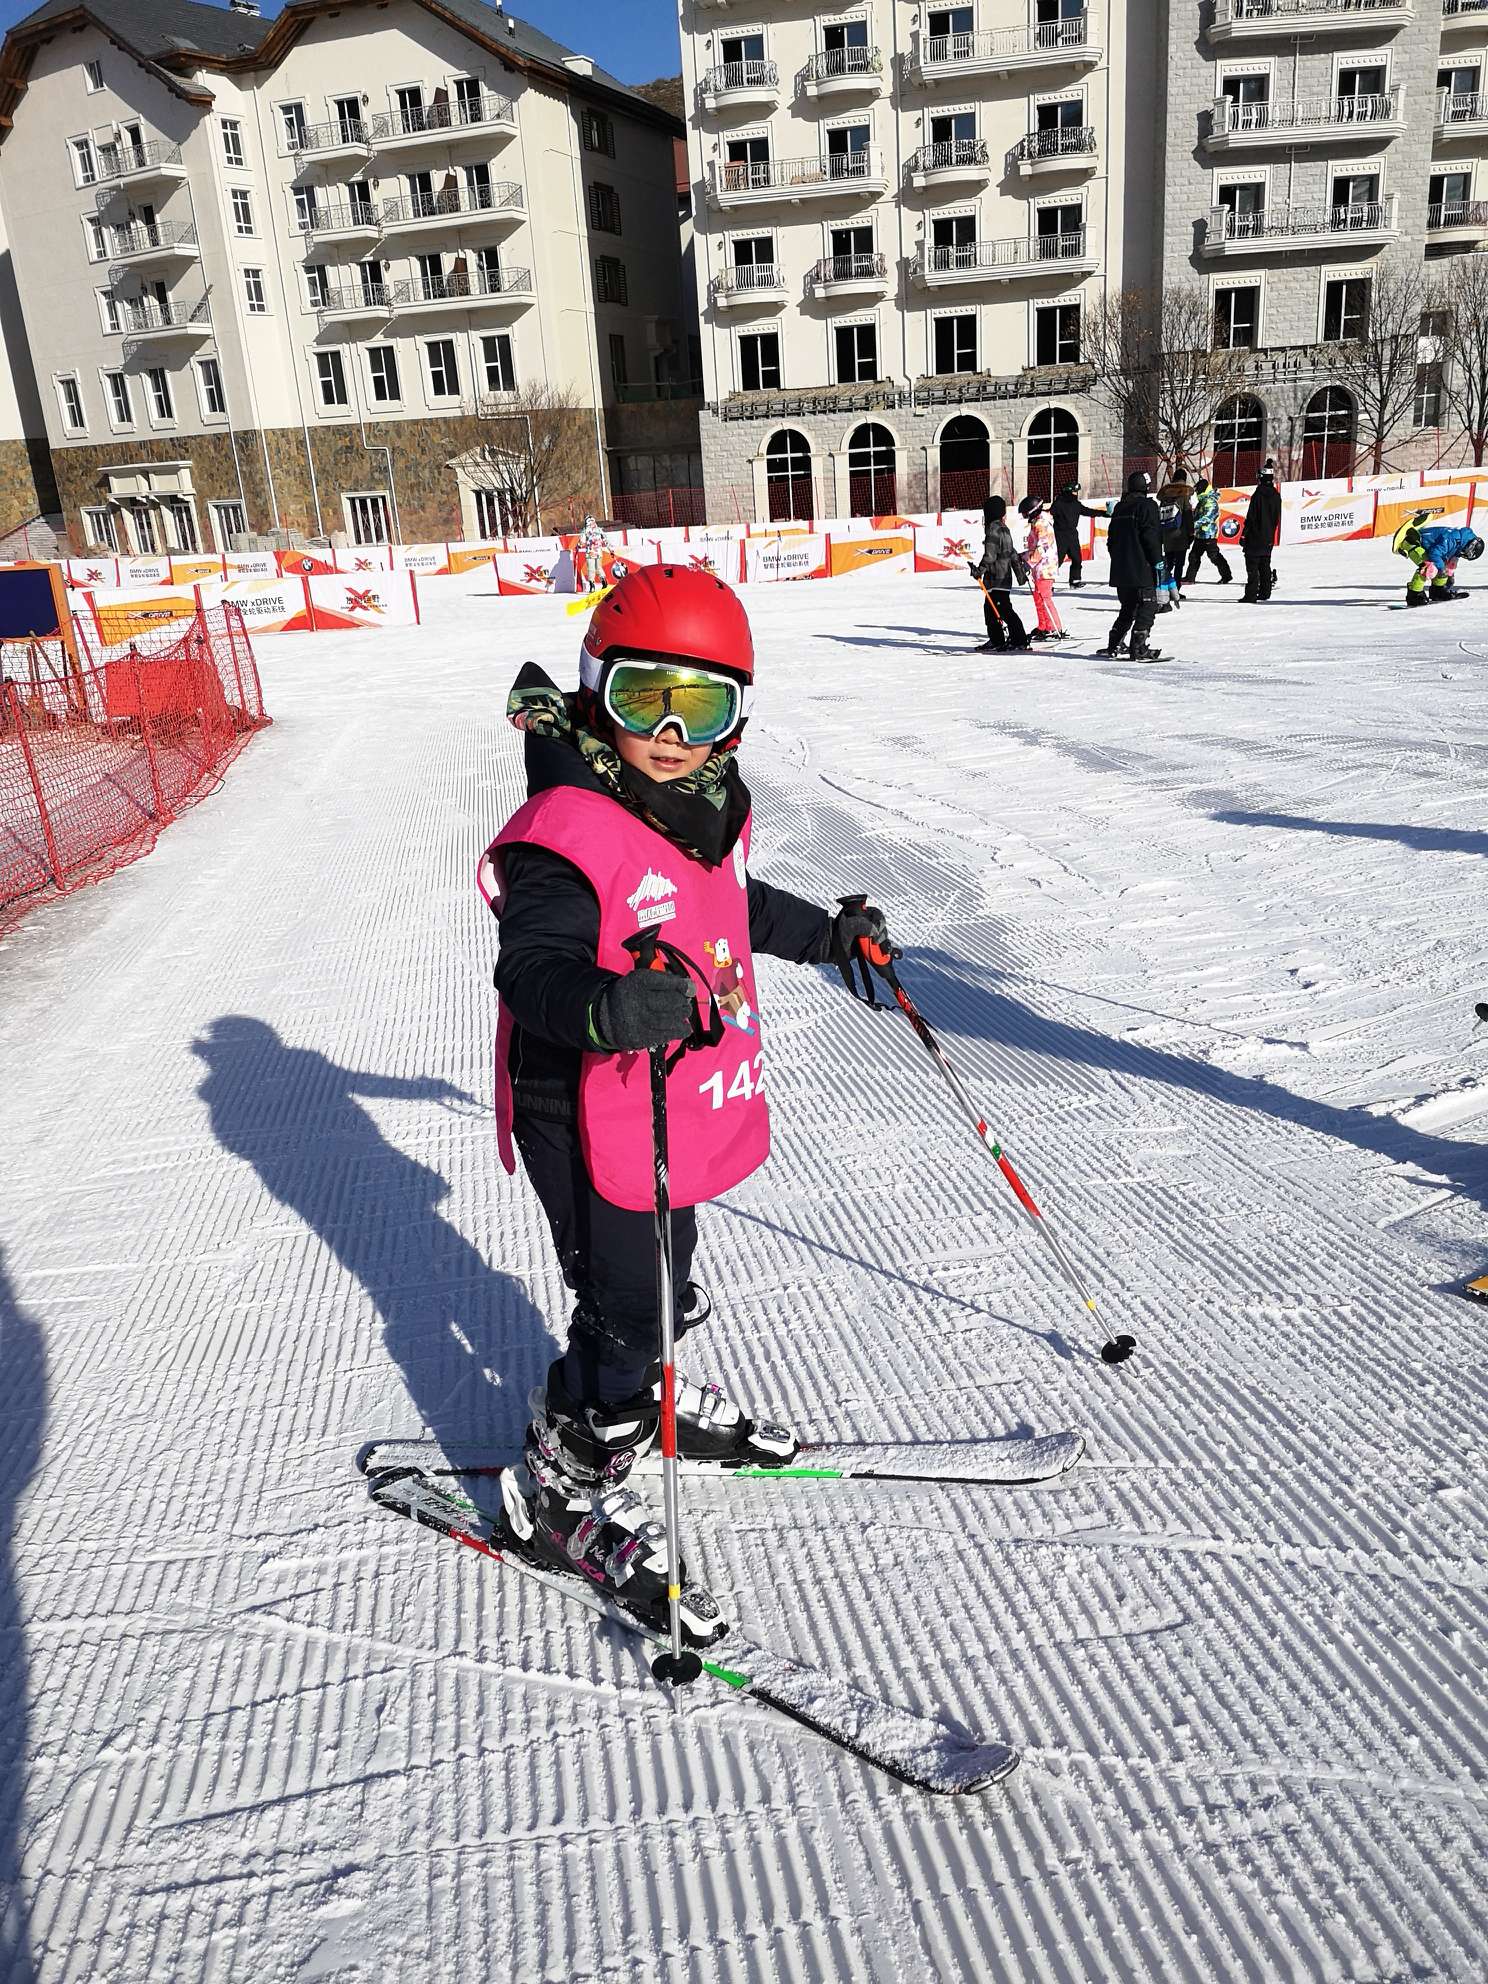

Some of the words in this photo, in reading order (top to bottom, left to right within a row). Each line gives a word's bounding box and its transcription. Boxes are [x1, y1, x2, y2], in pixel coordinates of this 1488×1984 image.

[1300, 515, 1322, 523] BMW
[1324, 512, 1354, 521] xDRIVE
[250, 596, 284, 606] xDRIVE
[698, 1050, 766, 1111] 142
